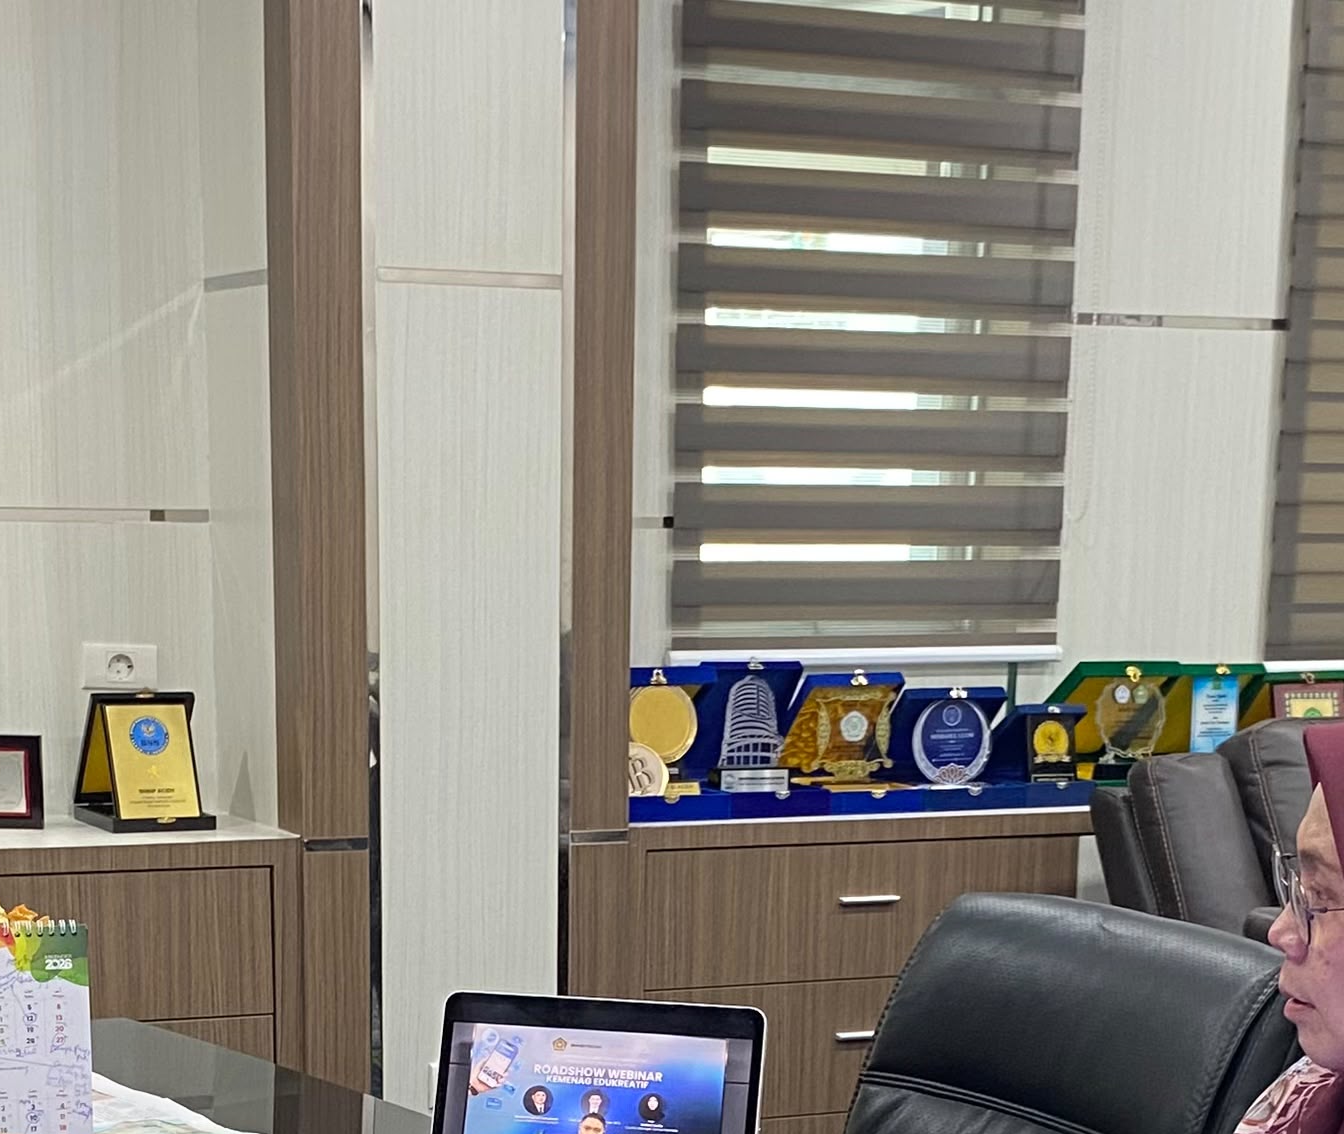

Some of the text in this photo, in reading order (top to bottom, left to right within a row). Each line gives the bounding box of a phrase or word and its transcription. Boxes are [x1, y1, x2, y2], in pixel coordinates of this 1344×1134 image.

[45, 959, 72, 970] 2026
[534, 1064, 663, 1082] ROADSHOW WEBINAR
[546, 1076, 649, 1089] KEMENAG EDUKREATIF
